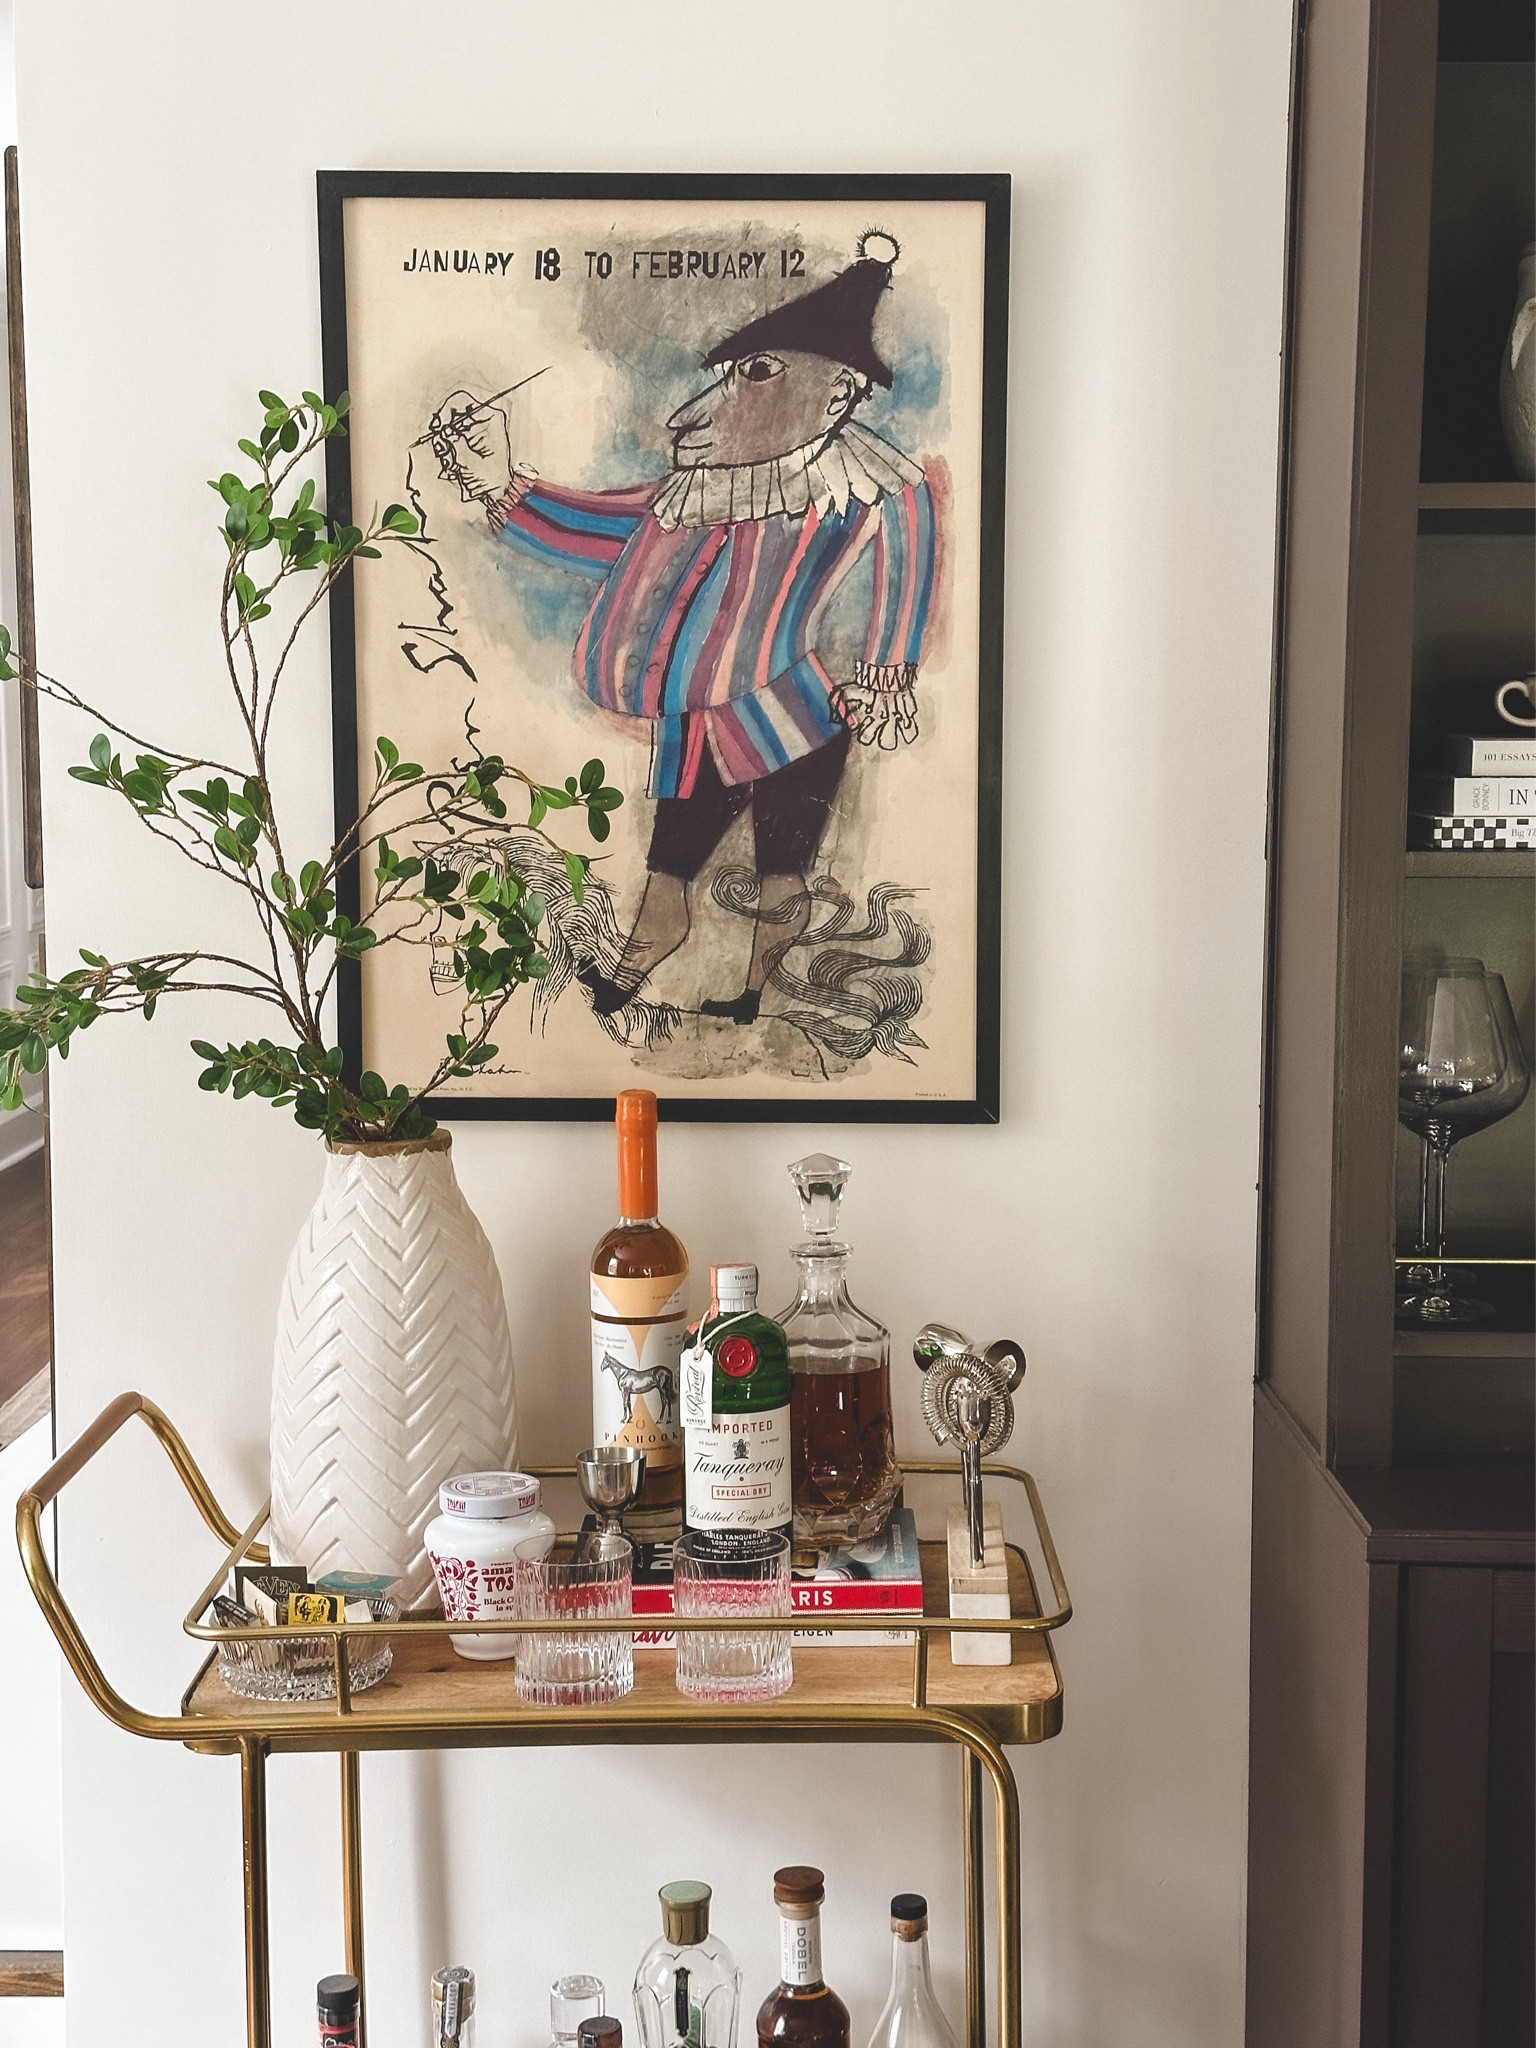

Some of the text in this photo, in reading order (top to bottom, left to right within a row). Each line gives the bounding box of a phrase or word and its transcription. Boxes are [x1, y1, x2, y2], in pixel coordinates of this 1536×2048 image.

[403, 246, 807, 282] JANUARY 18 TO FEBRUARY 12
[1484, 753, 1498, 761] 101
[1472, 786, 1481, 808] GRACE
[1482, 784, 1490, 811] BONNEY
[1509, 789, 1528, 805] IN
[686, 1365, 706, 1417] Revival
[604, 1431, 678, 1444] PINHOOK
[692, 1452, 785, 1481] Tanqueray
[715, 1486, 768, 1497] SPECIAL DRY
[688, 1502, 790, 1526] Distilled English Gin
[481, 1568, 513, 1576] ama
[252, 1576, 301, 1596] EVEN
[483, 1577, 514, 1593] TOS
[483, 1598, 506, 1606] Black
[791, 1590, 834, 1606] RIS
[796, 1927, 807, 1981] DOBEL
